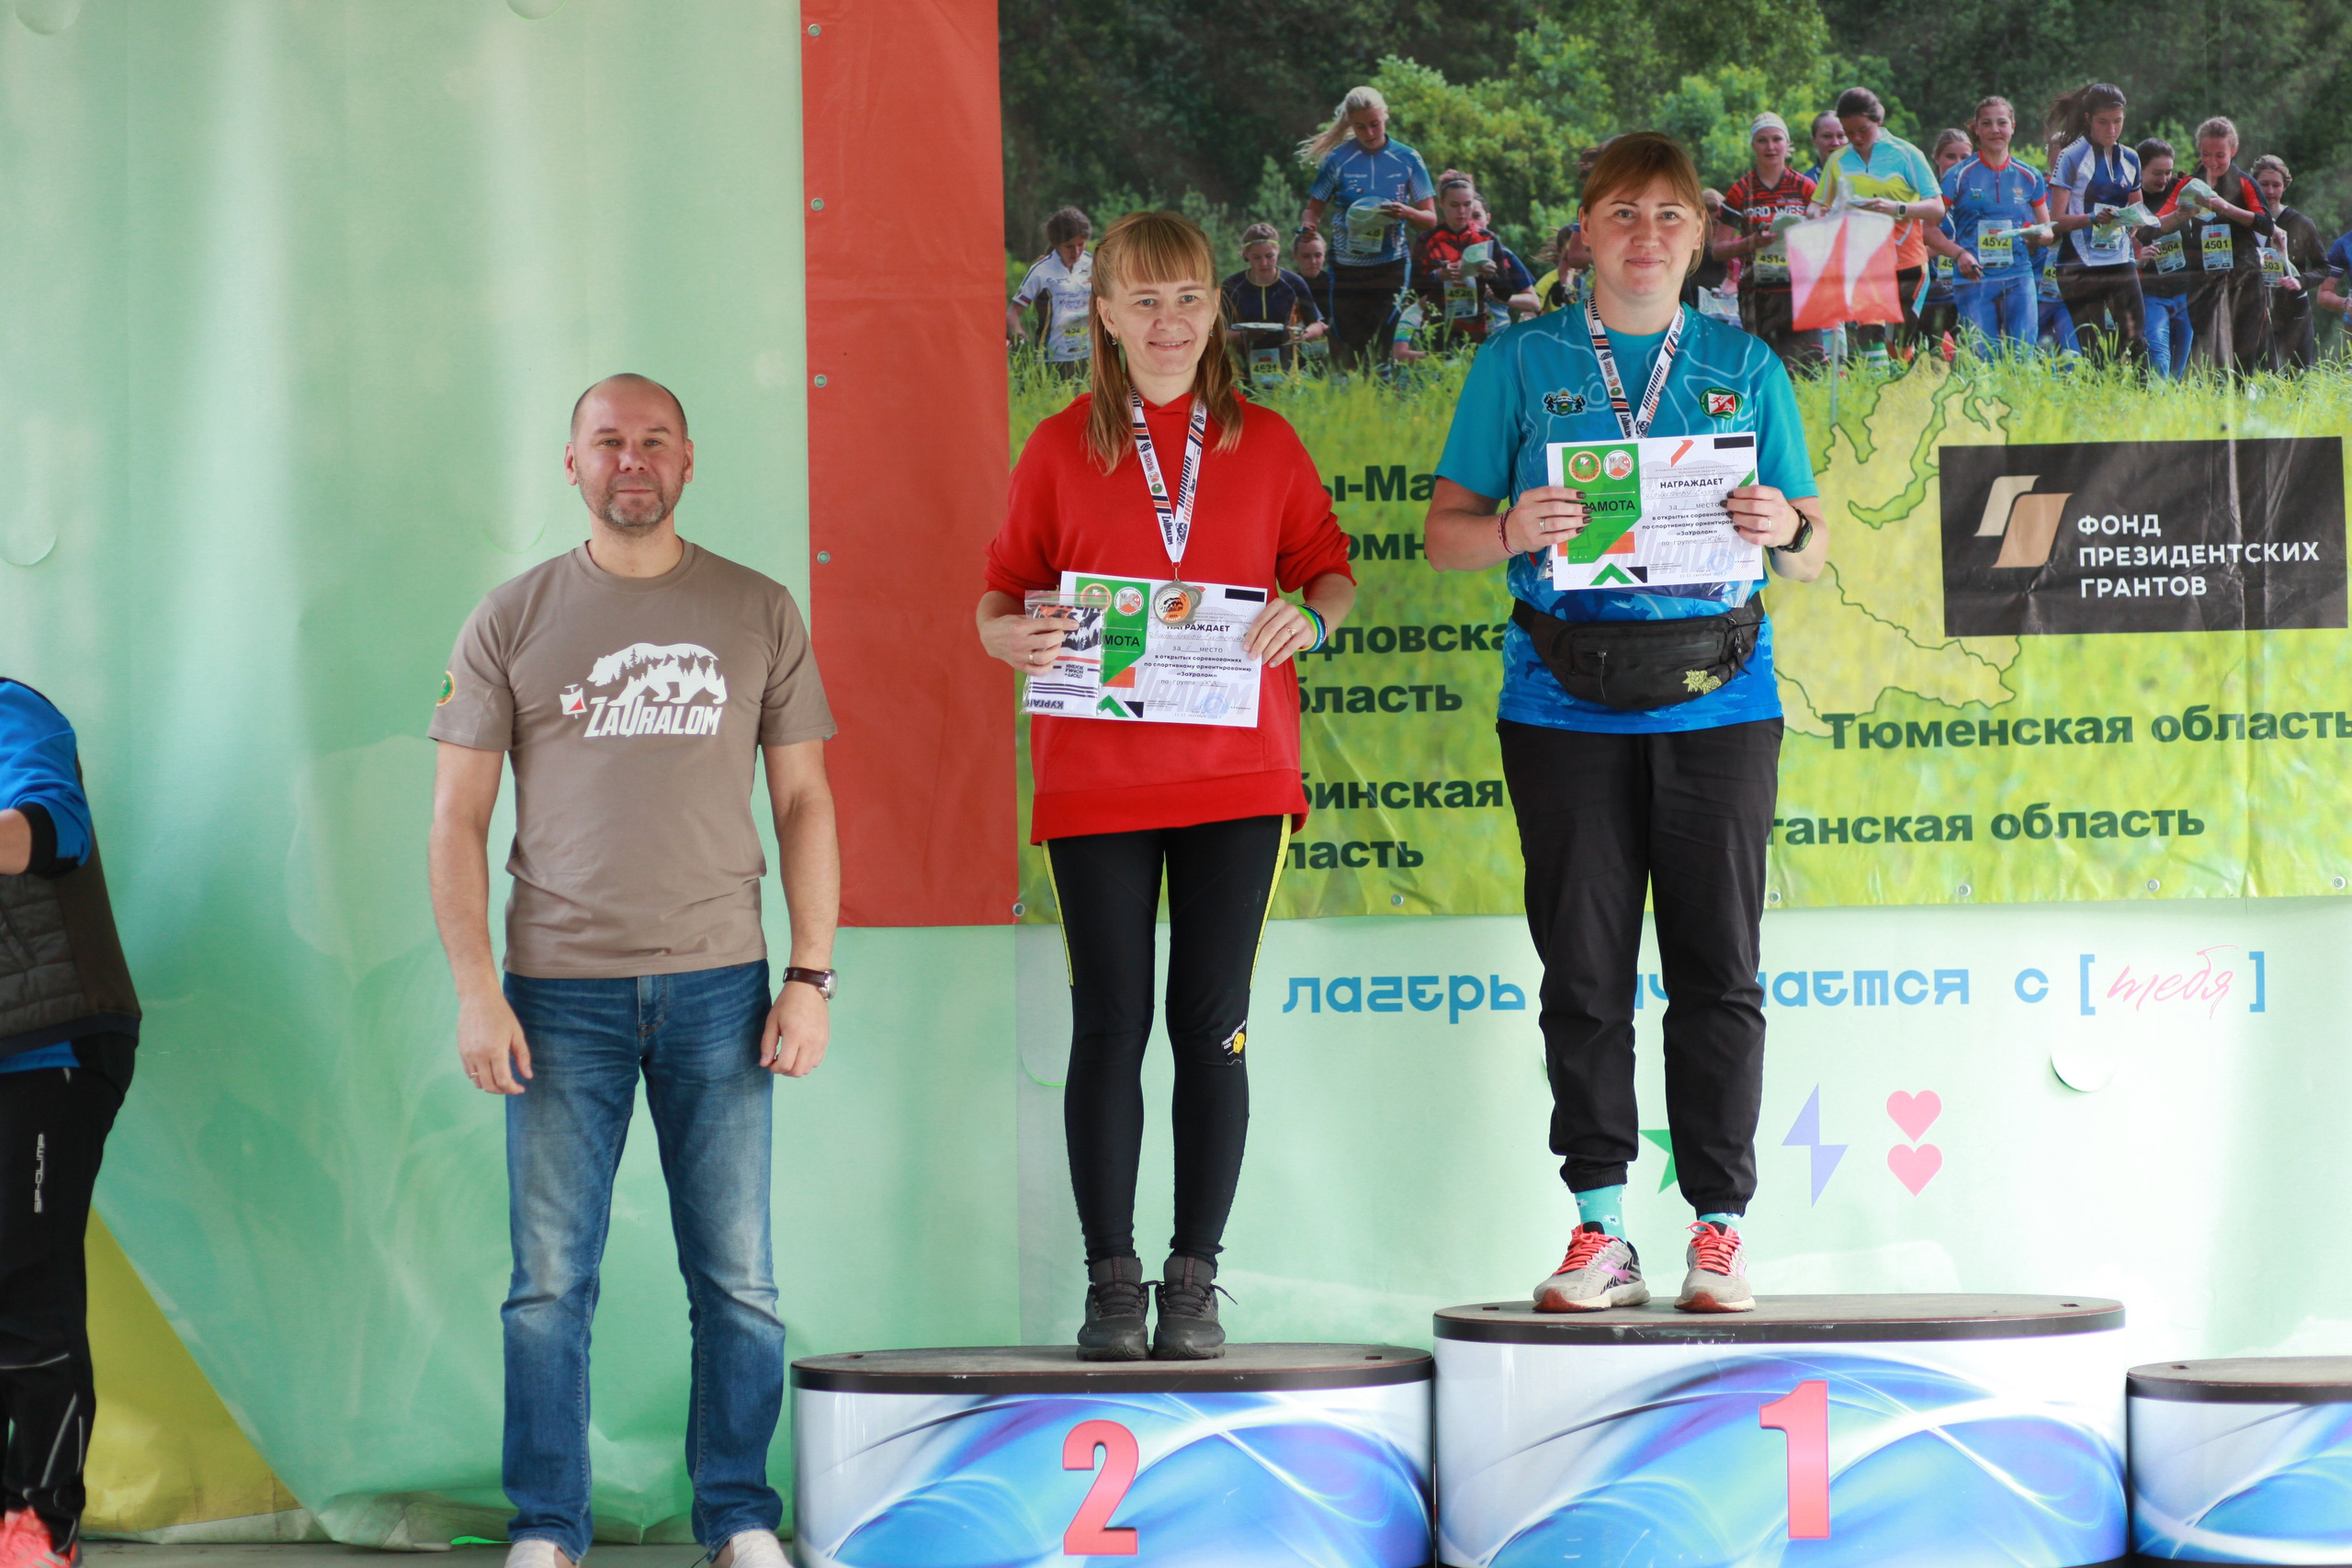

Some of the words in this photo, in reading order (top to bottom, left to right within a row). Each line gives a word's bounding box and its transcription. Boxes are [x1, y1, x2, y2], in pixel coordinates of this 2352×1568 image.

[1982, 236, 2008, 247] 4512
[2204, 239, 2229, 250] 4501
[1941, 260, 1954, 269] 45
[2263, 261, 2280, 271] 503
[1660, 478, 1724, 489] НАГРАЖДАЕТ
[1580, 500, 1635, 512] РАМОТА
[1690, 512, 1728, 520] соревнова
[1695, 520, 1736, 528] ориентиров
[2077, 514, 2161, 537] ФОНД
[2079, 542, 2320, 568] ПРЕЗИДЕНТСКИХ
[2080, 576, 2207, 598] ГРАНТОВ
[1104, 635, 1140, 647] МОТА
[1196, 664, 1252, 672] ориентированию
[1821, 713, 2133, 750] Тюменская
[2151, 704, 2352, 743] область
[1991, 803, 2205, 841] область
[1283, 840, 1424, 870] ласть
[1283, 975, 1525, 1024] лагерь
[2014, 968, 2049, 1004] с
[1758, 1380, 1831, 1540] 1
[1062, 1418, 1139, 1556] 2
